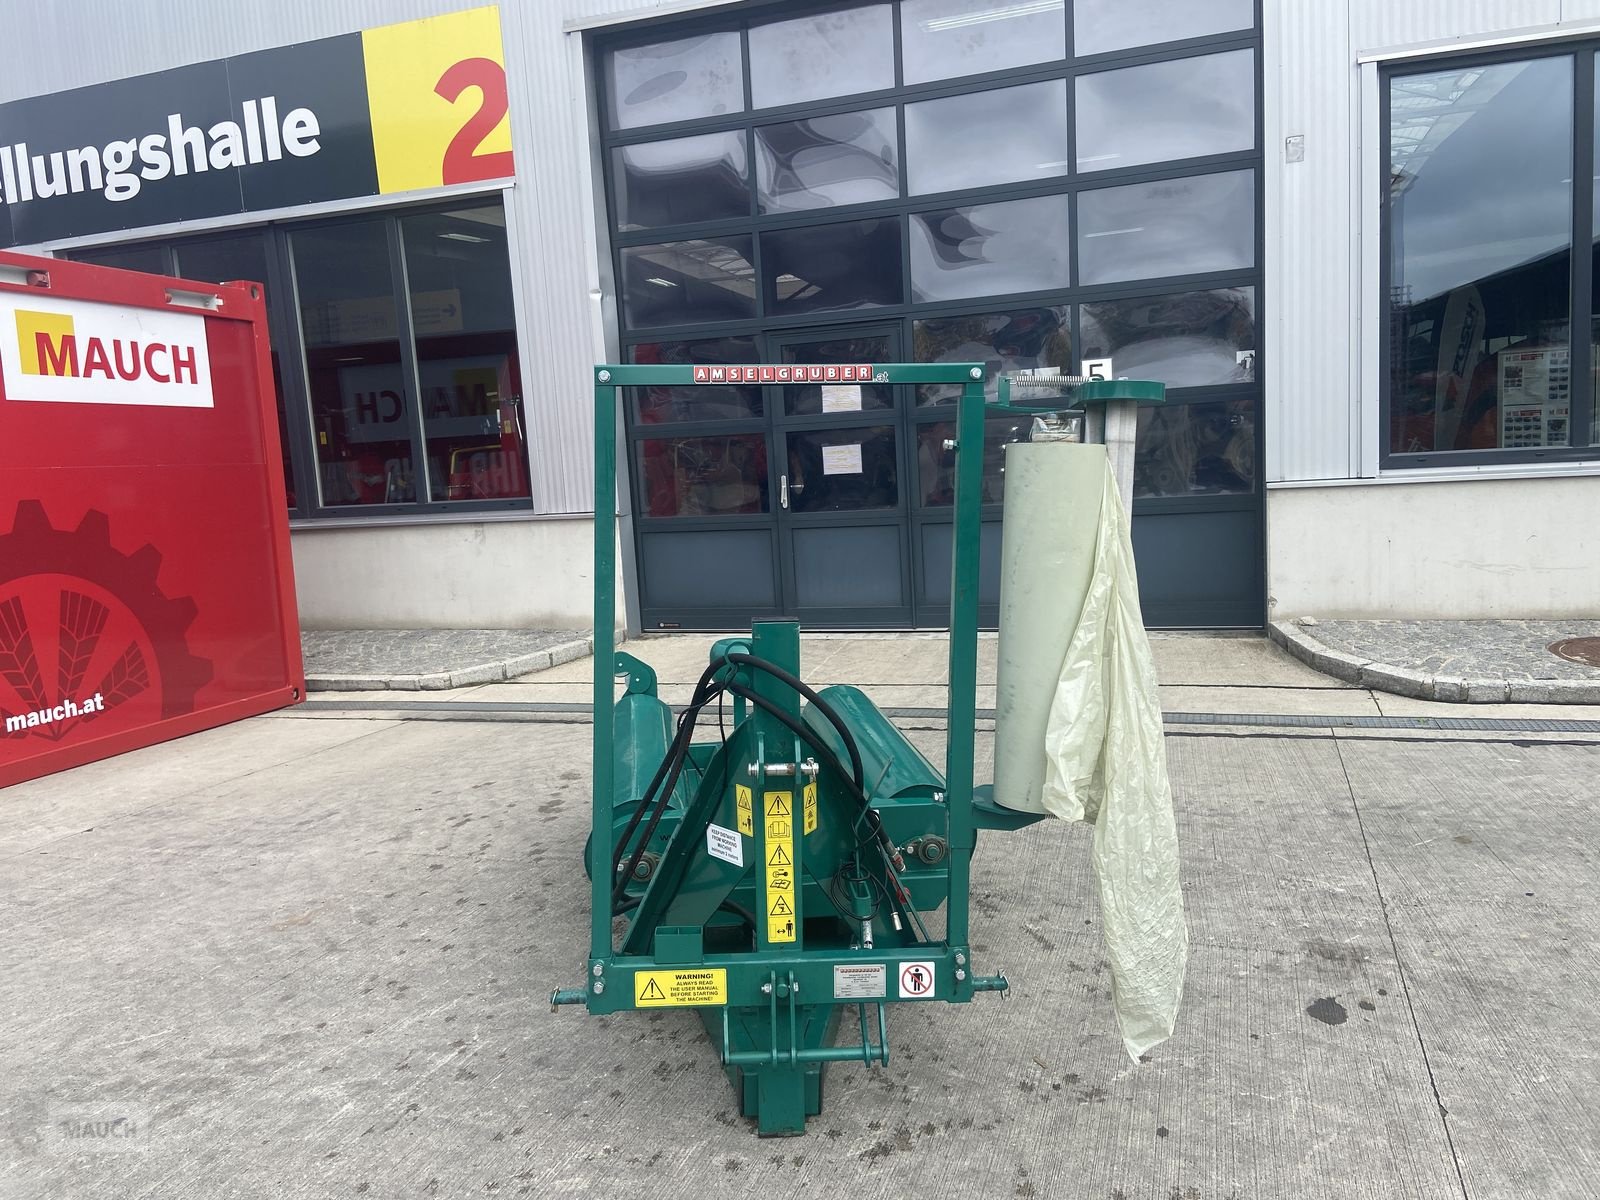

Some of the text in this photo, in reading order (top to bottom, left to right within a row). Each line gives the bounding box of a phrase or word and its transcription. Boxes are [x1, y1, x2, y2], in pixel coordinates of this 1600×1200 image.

[0, 57, 515, 204] llungshalle 2
[34, 332, 198, 384] MAUCH
[6, 693, 104, 732] mauch.at
[718, 843, 732, 852] MACHINE
[720, 832, 736, 842] DISTANCE
[722, 838, 737, 848] WORKING
